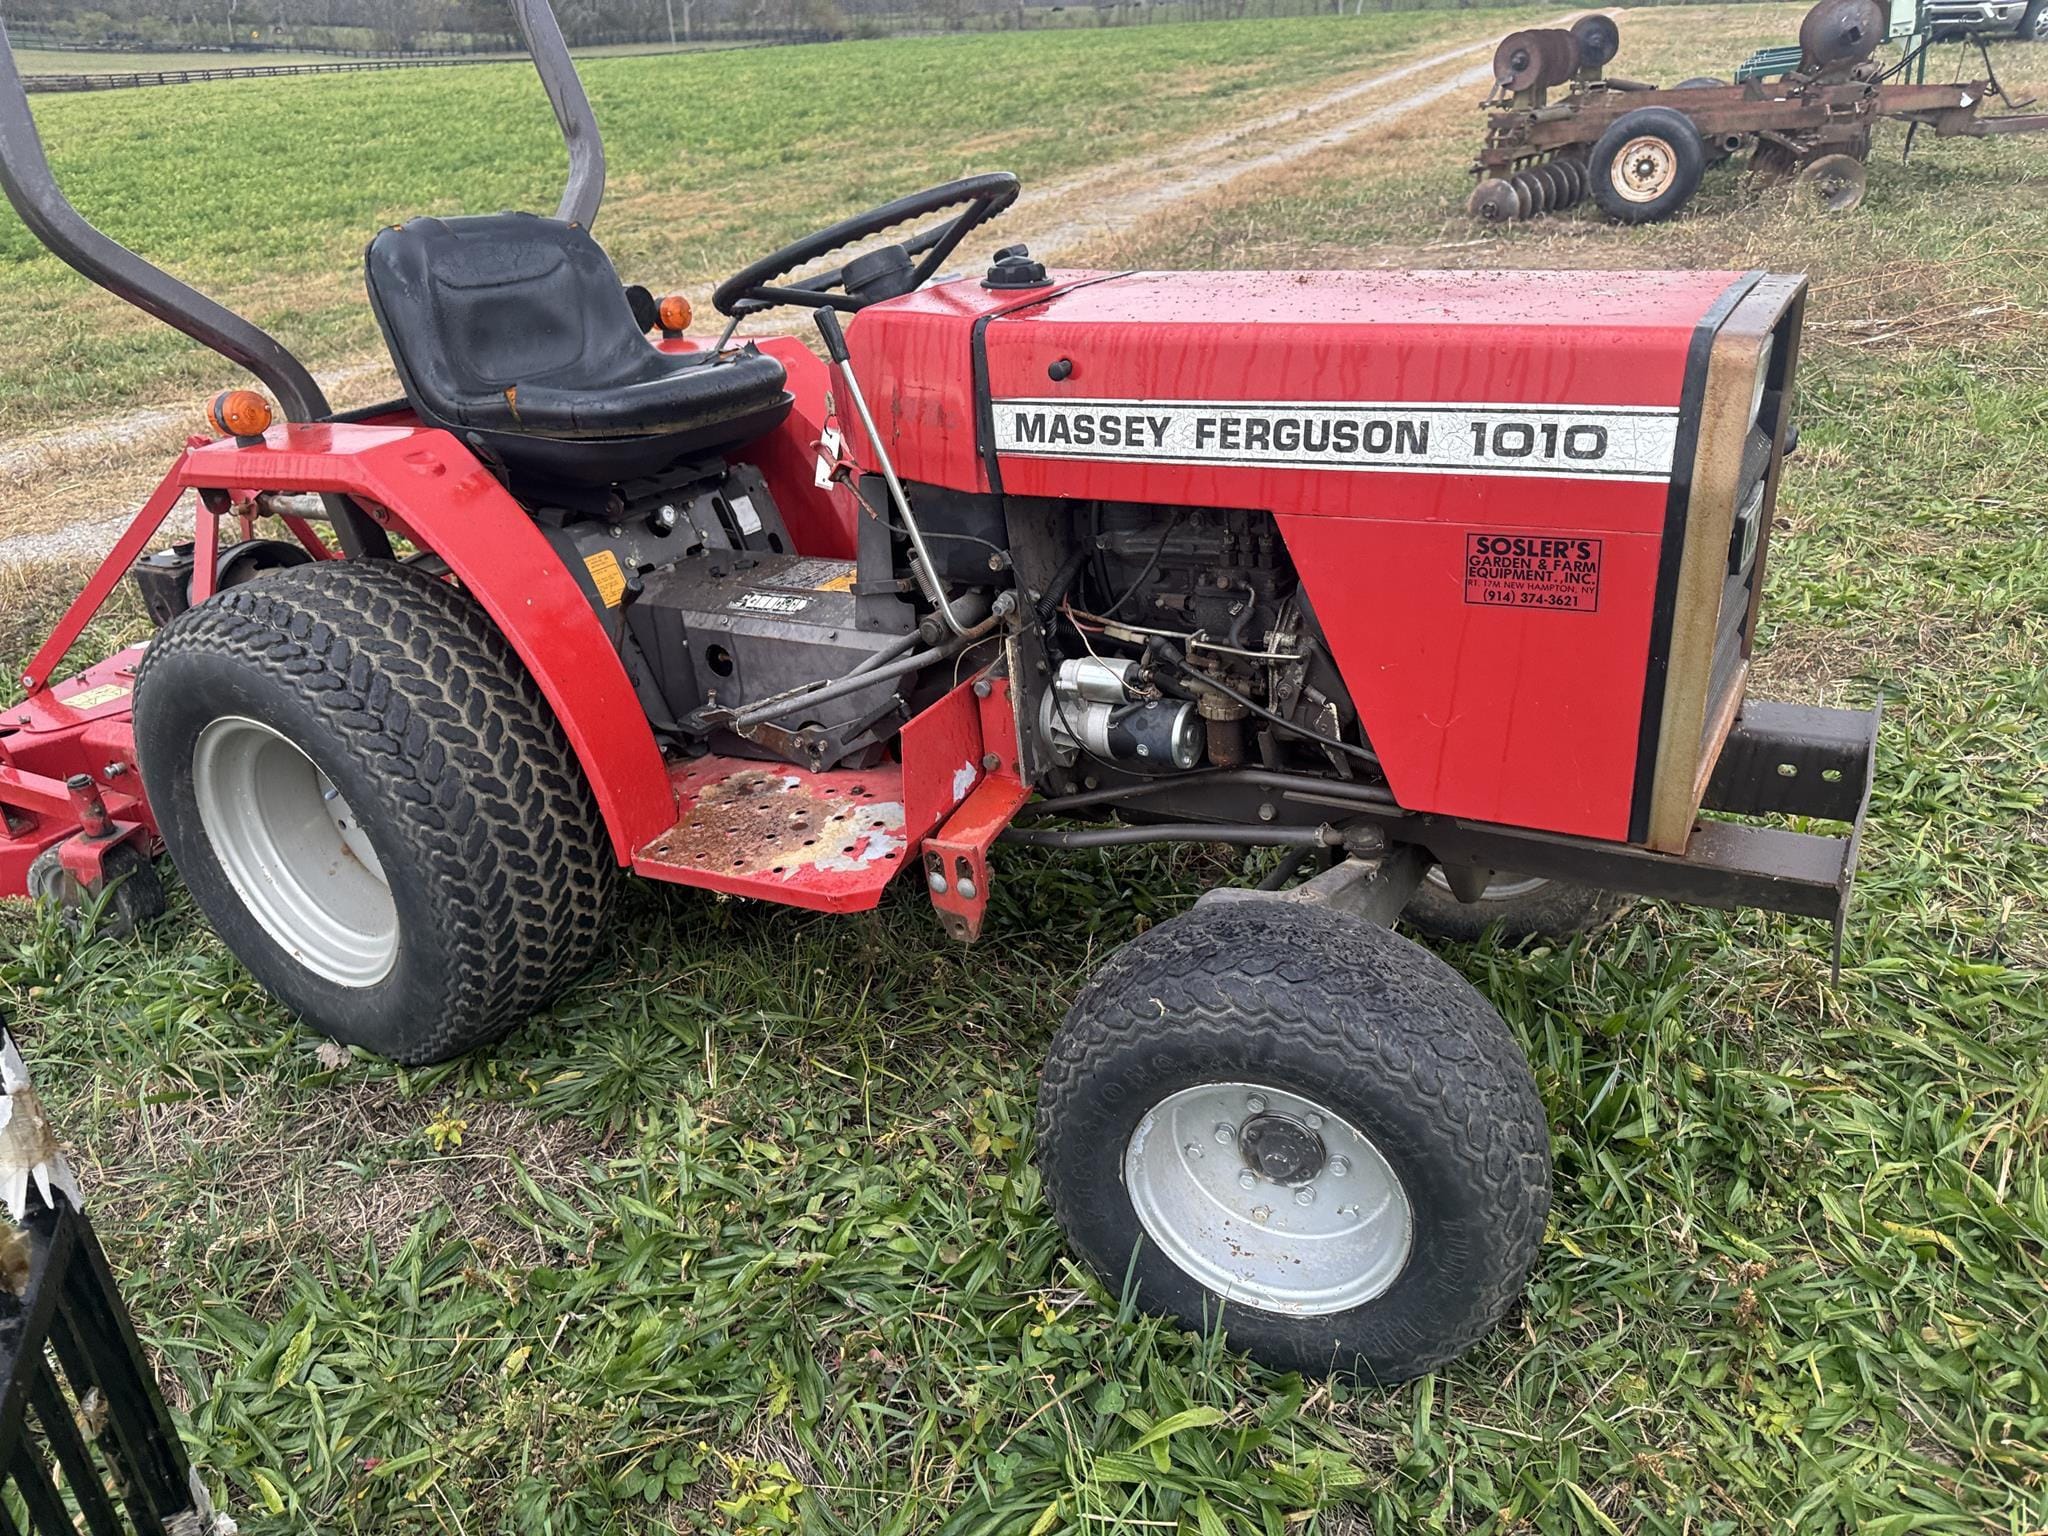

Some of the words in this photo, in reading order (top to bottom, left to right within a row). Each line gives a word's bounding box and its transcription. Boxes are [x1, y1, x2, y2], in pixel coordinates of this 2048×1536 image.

[1015, 413, 1171, 448] MASSEY
[1195, 417, 1430, 455] FERGUSON
[1470, 421, 1608, 460] 1010
[1476, 537, 1591, 560] SOSLER'S
[1469, 555, 1531, 569] GARDEN
[1538, 559, 1547, 570] &
[1553, 560, 1596, 573] FARM
[1504, 581, 1525, 590] NEW
[1581, 586, 1595, 594] NY
[1483, 588, 1515, 604] (914)
[1521, 592, 1578, 606] 374-3621
